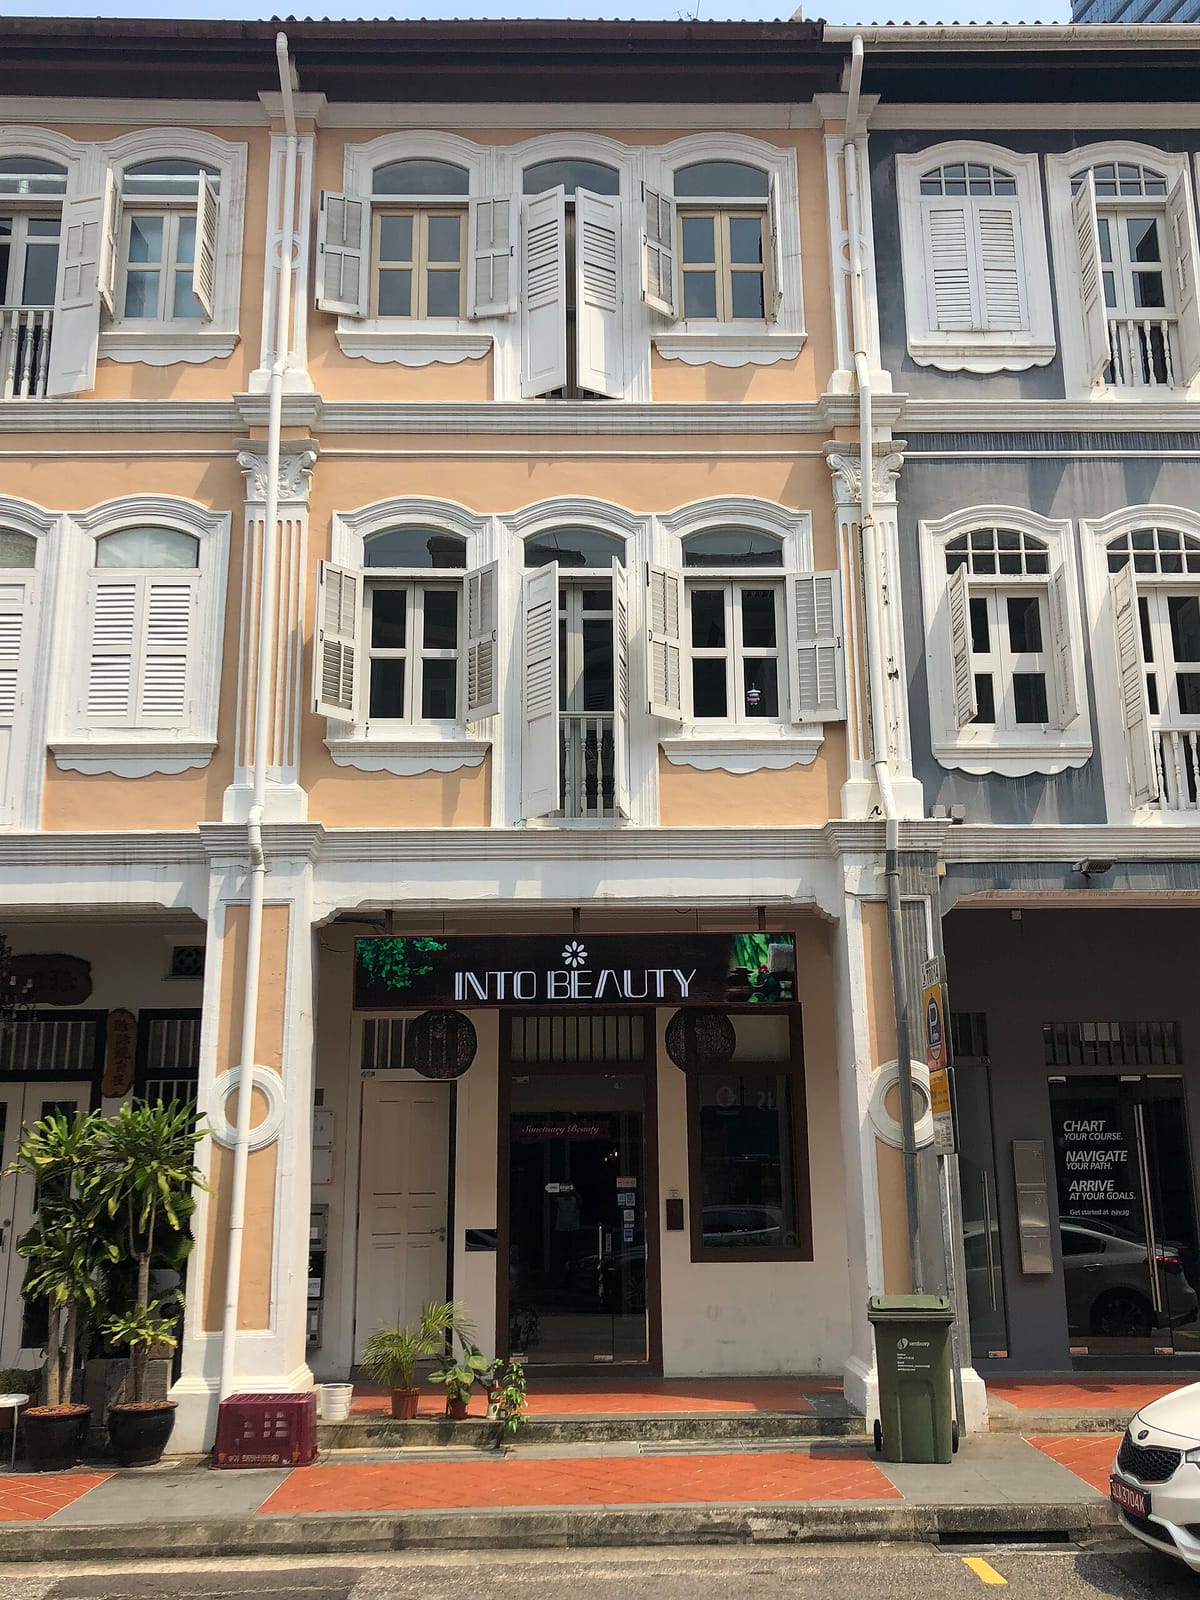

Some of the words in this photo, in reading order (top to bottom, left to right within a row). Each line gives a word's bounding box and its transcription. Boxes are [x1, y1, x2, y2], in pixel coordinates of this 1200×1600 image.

[454, 971, 537, 1001] INTO
[546, 968, 697, 1000] BEAUTY
[521, 1125, 566, 1136] Sanctuary
[567, 1124, 600, 1135] Beauty
[1063, 1120, 1106, 1132] CHART
[1064, 1133, 1088, 1141] YOUR
[1088, 1132, 1123, 1141] COURSE.
[1065, 1150, 1128, 1162] NAVIGATE
[1066, 1162, 1089, 1170] YOUR
[1090, 1162, 1113, 1170] PATH.
[1068, 1179, 1115, 1192] ARRIVE
[1069, 1192, 1080, 1201] AT
[1081, 1192, 1105, 1201] YOUR
[1106, 1191, 1137, 1200] GOALS.
